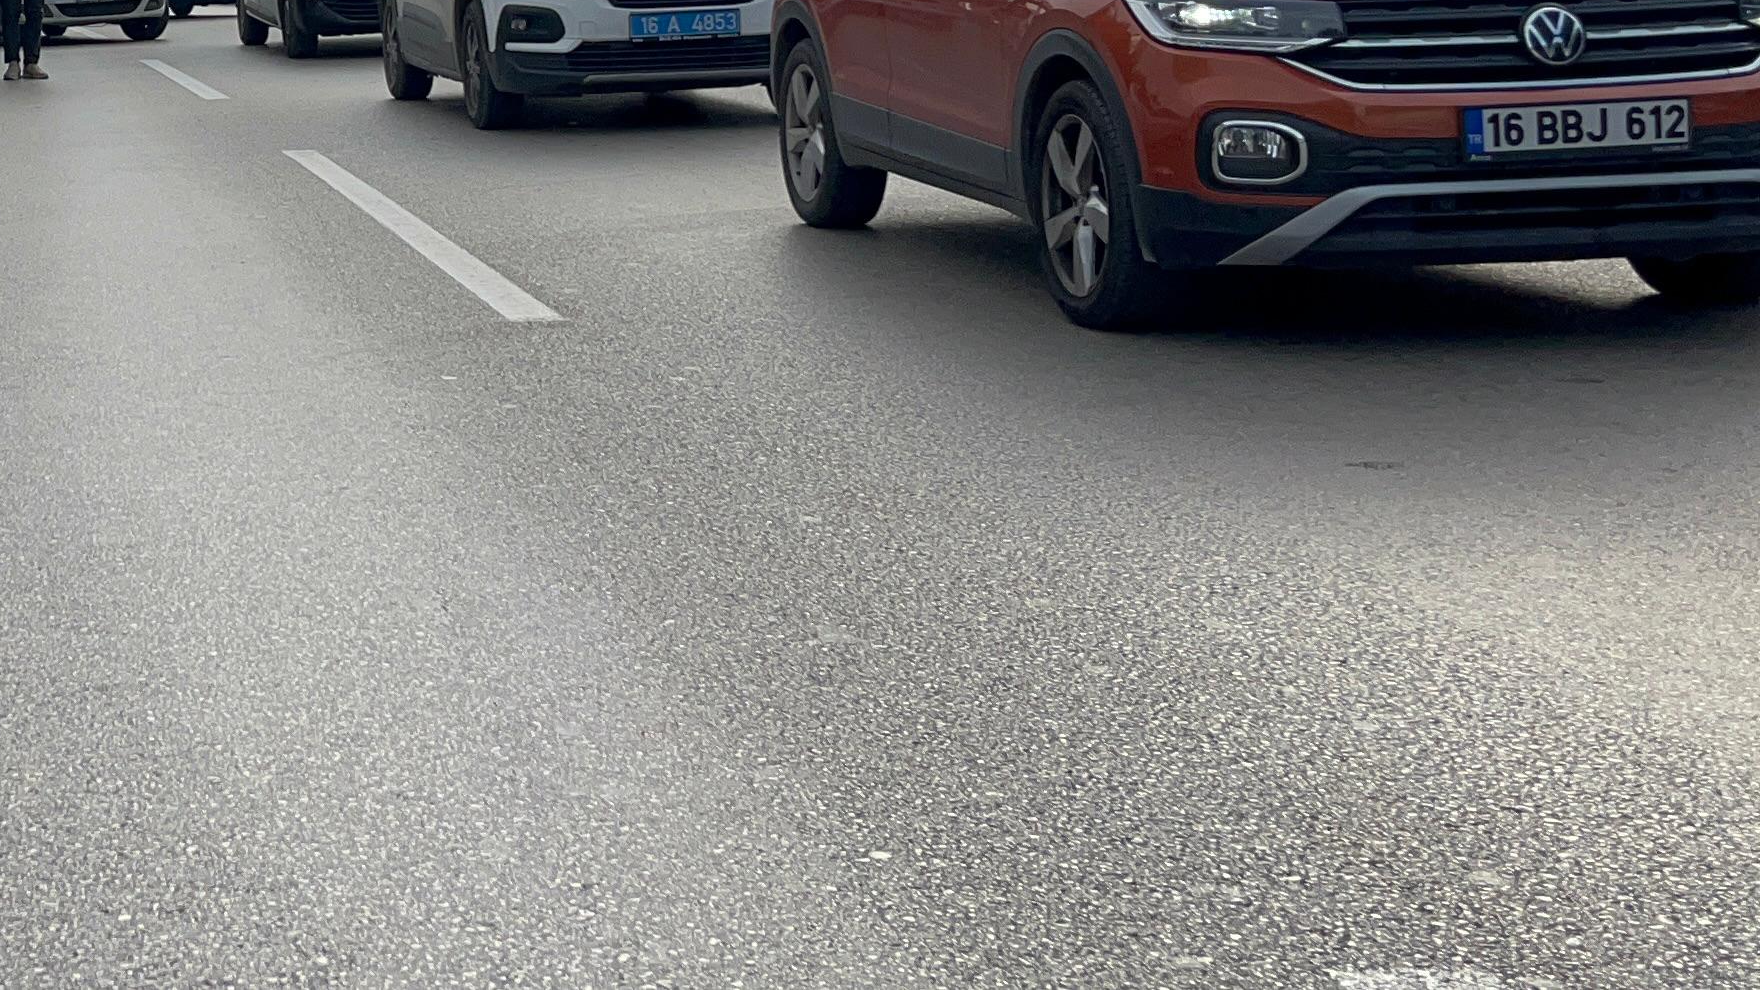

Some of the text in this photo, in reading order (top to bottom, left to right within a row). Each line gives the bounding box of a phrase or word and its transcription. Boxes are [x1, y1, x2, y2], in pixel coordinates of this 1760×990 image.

[640, 12, 737, 34] 16 A 4853
[1488, 112, 1525, 147] 16
[1536, 107, 1608, 145] BBJ
[1626, 104, 1686, 140] 612
